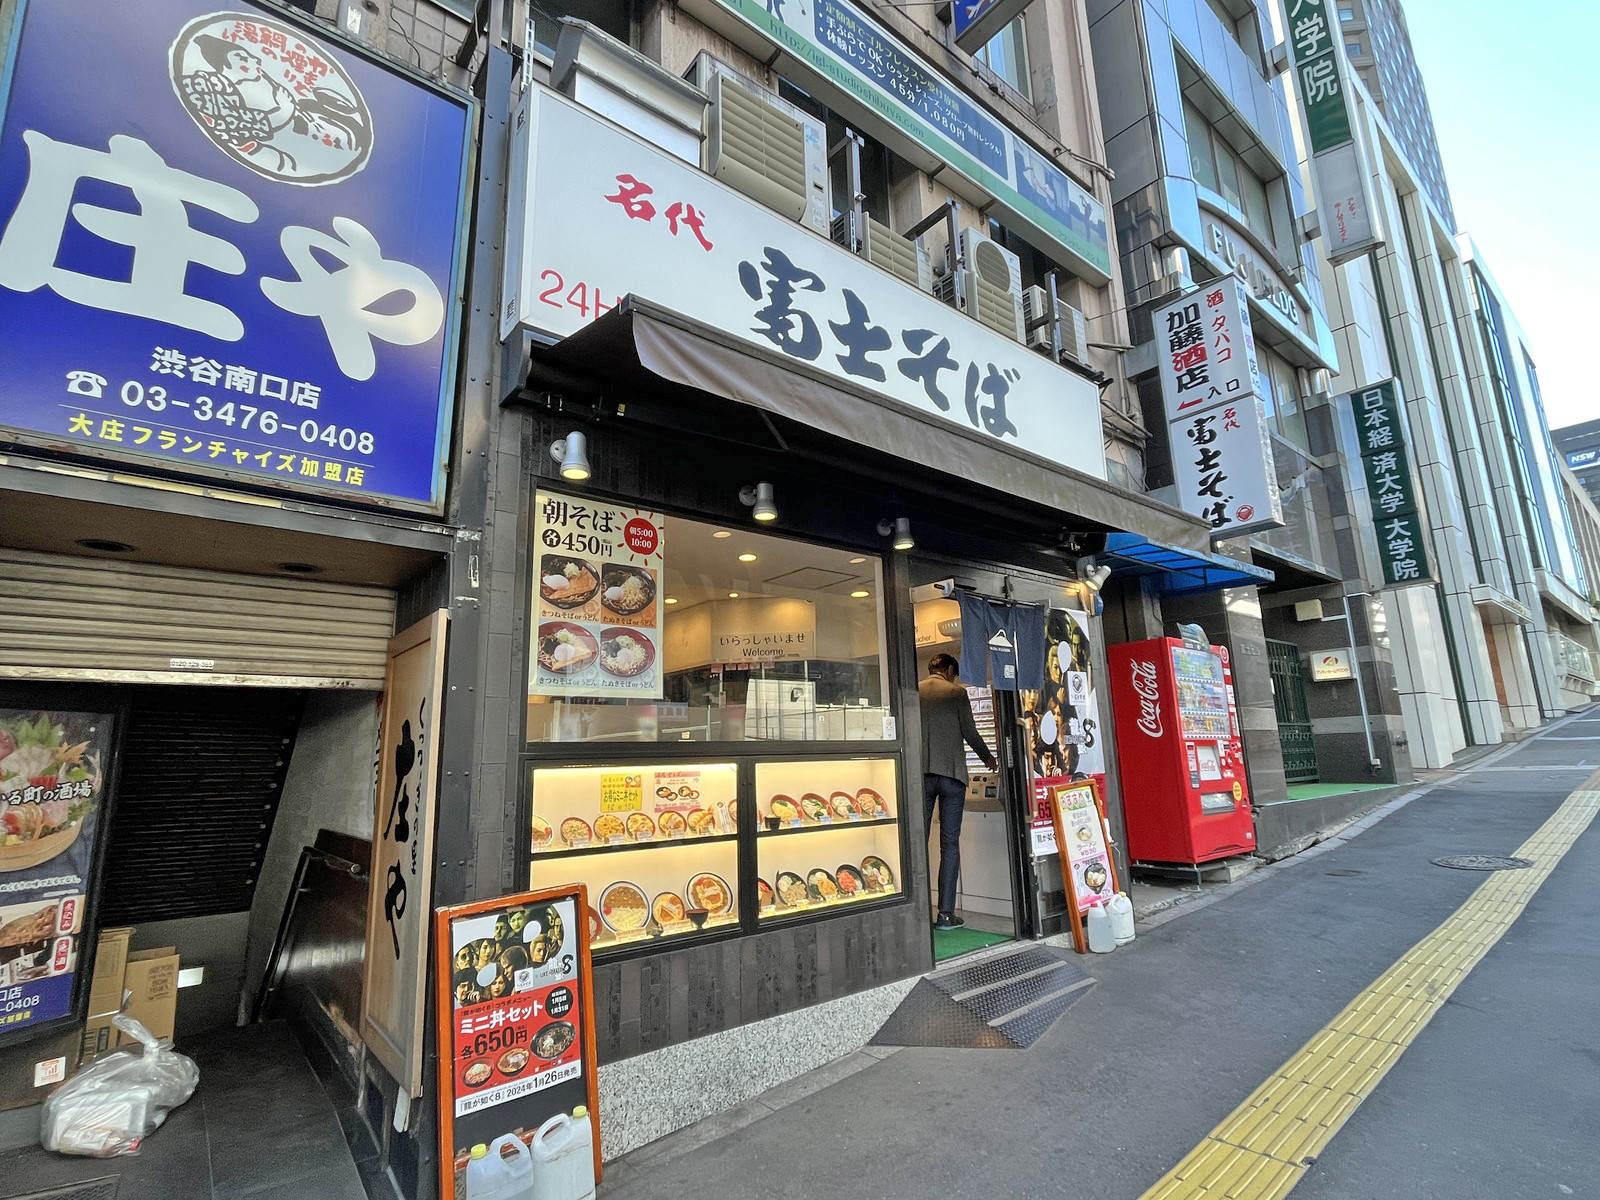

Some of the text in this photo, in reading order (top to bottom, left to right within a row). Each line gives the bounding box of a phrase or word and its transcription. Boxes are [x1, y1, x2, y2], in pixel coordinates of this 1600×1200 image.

[603, 173, 715, 252] 名代
[0, 129, 445, 381] 庄や
[737, 246, 1021, 439] 富士そば
[1165, 302, 1210, 394] 加藤酒店
[1206, 288, 1232, 364] 酒・タバコ
[148, 345, 323, 410] 渋谷南口店
[1207, 378, 1241, 400] 入口
[120, 379, 375, 455] 03-3476-0408
[1221, 407, 1241, 432] 名代
[67, 412, 366, 487] 大庄フランチャイズ加盟店
[542, 498, 616, 533] 朝そば
[631, 537, 652, 549] 10:00
[719, 633, 806, 647] いらっしゃいませ
[742, 648, 784, 657] Welcome
[460, 999, 544, 1034] ミニ丼セット
[460, 1026, 529, 1060] 各650円
